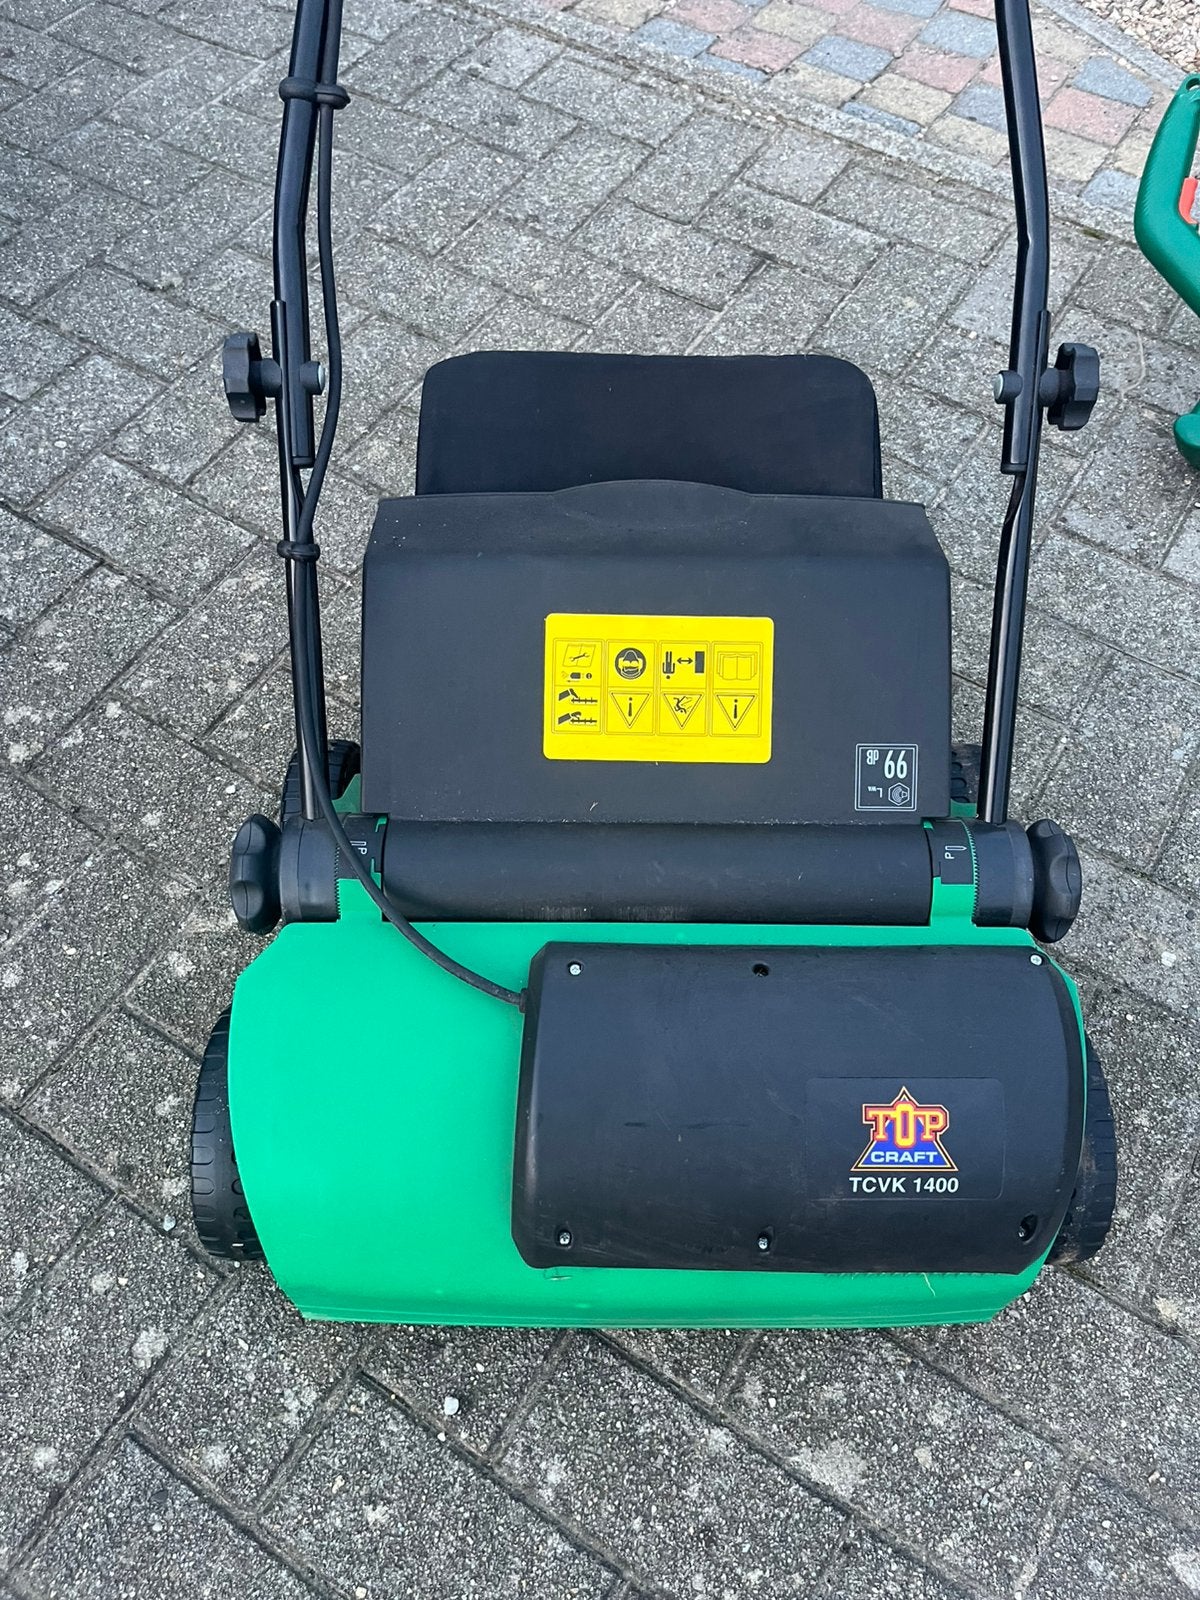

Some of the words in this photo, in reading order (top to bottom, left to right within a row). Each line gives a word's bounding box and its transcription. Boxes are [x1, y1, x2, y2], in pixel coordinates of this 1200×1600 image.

[866, 750, 879, 765] dB
[884, 750, 907, 779] 99
[867, 1102, 946, 1147] TOP
[870, 1151, 937, 1163] CRAFT
[849, 1177, 906, 1193] TCVK
[913, 1177, 959, 1193] 1400
